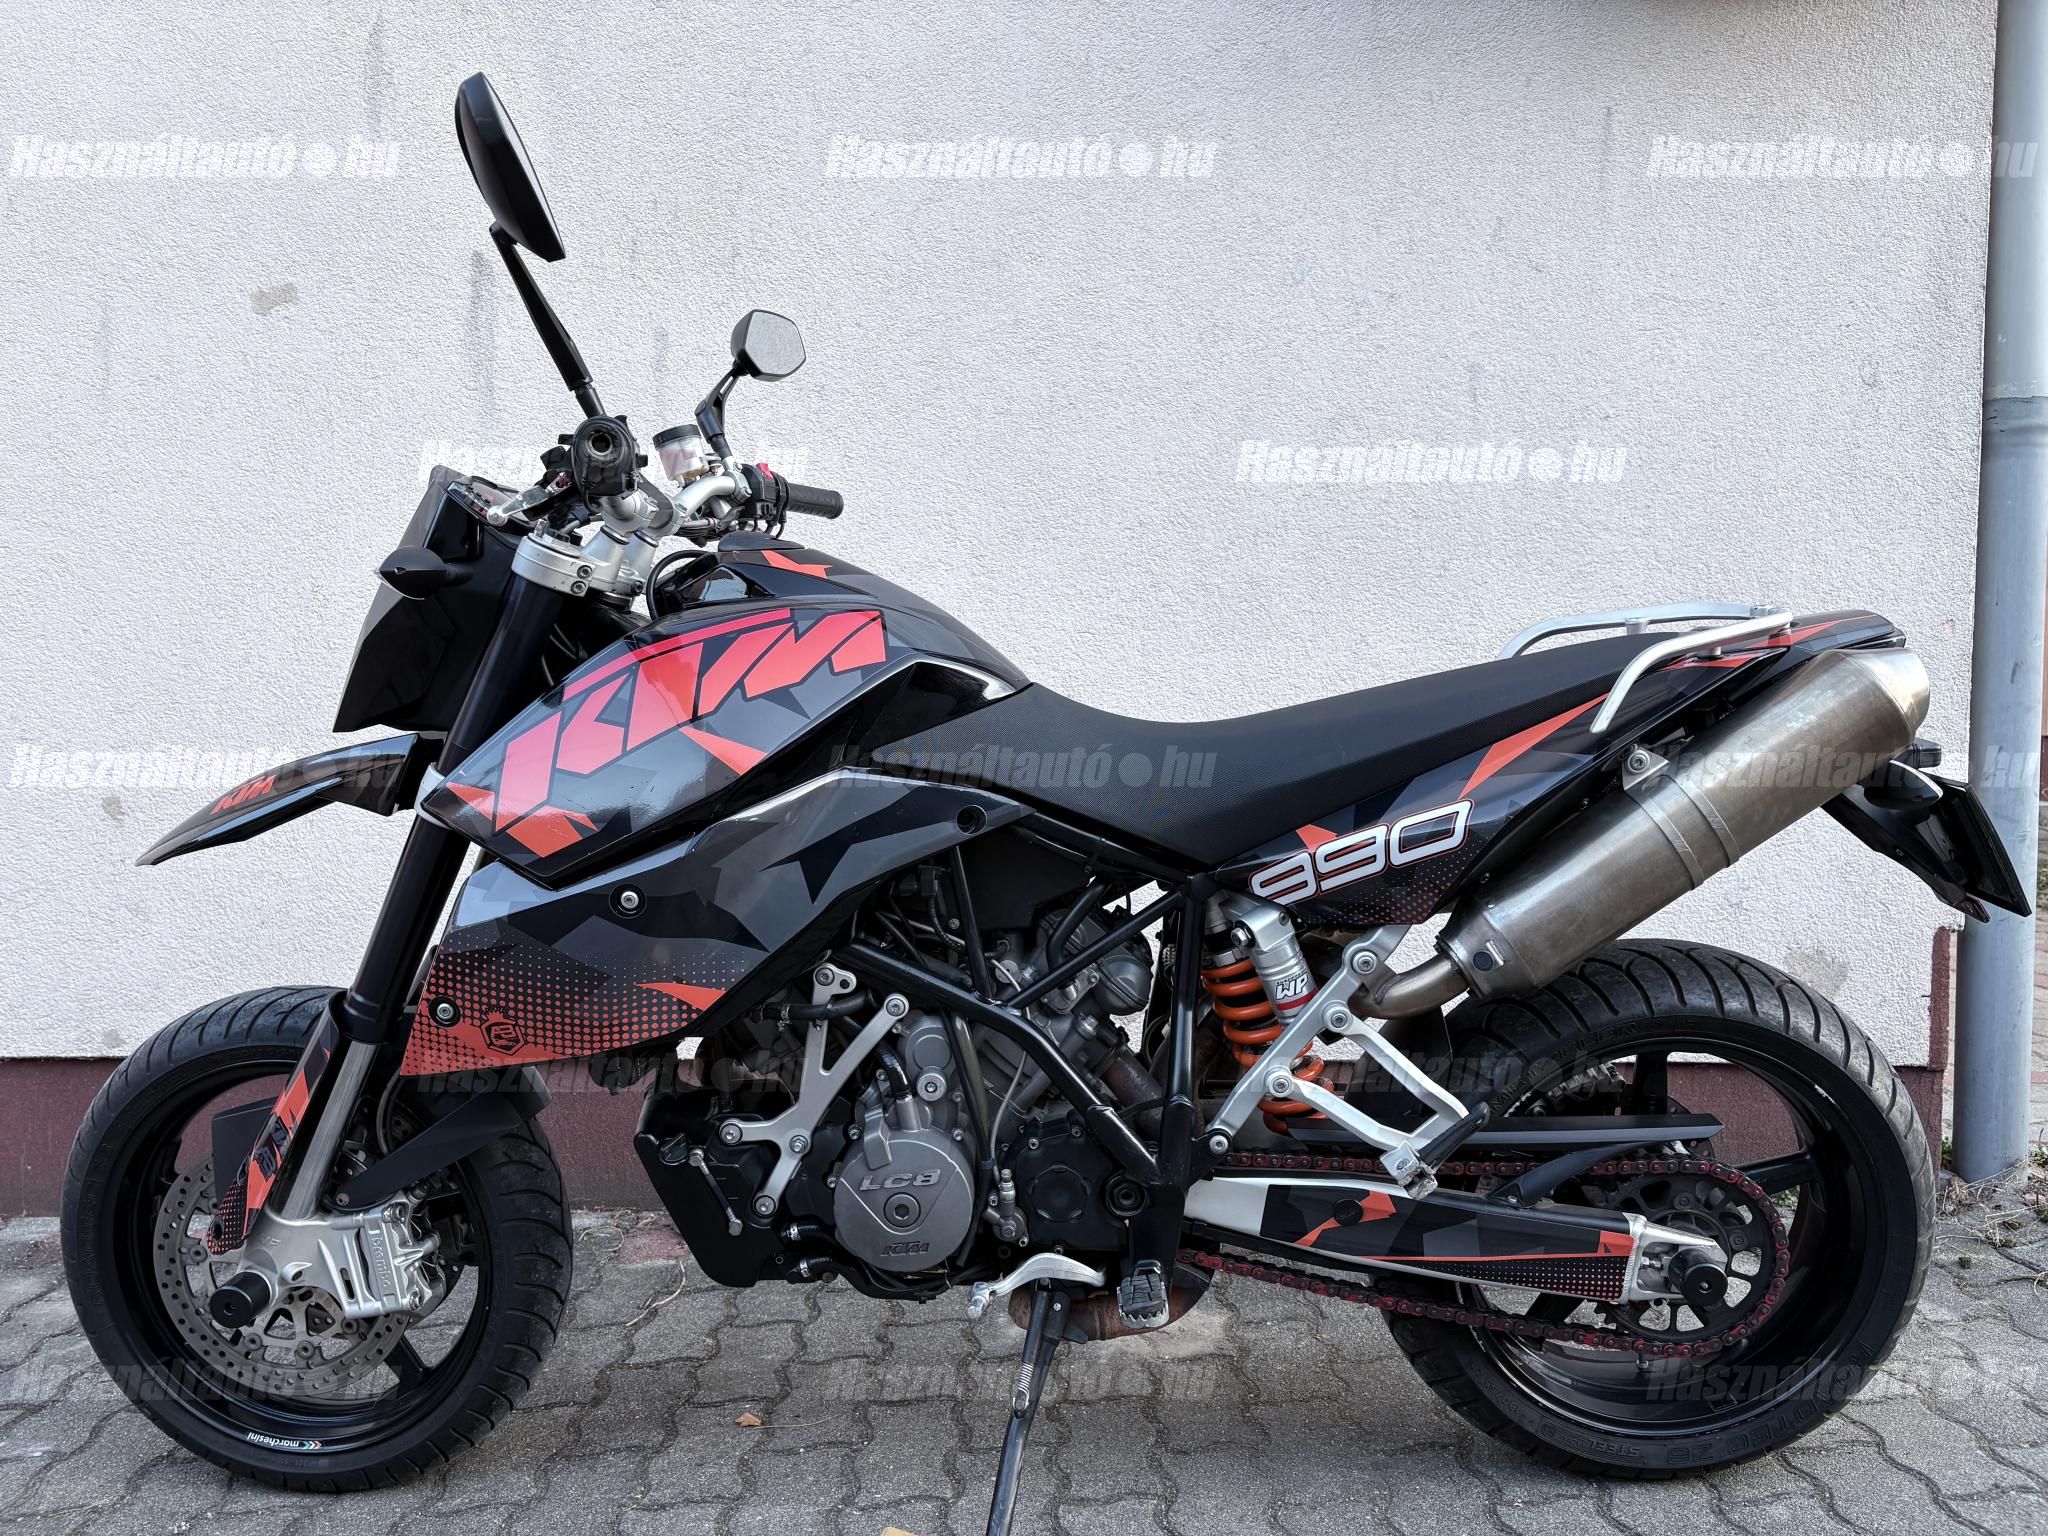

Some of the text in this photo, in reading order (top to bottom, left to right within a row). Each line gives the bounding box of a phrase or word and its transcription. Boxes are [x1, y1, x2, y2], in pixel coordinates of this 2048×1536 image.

[495, 607, 888, 834] KTM
[210, 774, 277, 815] KTM
[1249, 799, 1475, 907] 990
[1276, 971, 1309, 1000] WP
[859, 1169, 941, 1191] LC8
[880, 1240, 930, 1257] KTM
[247, 1432, 300, 1447] marchesini
